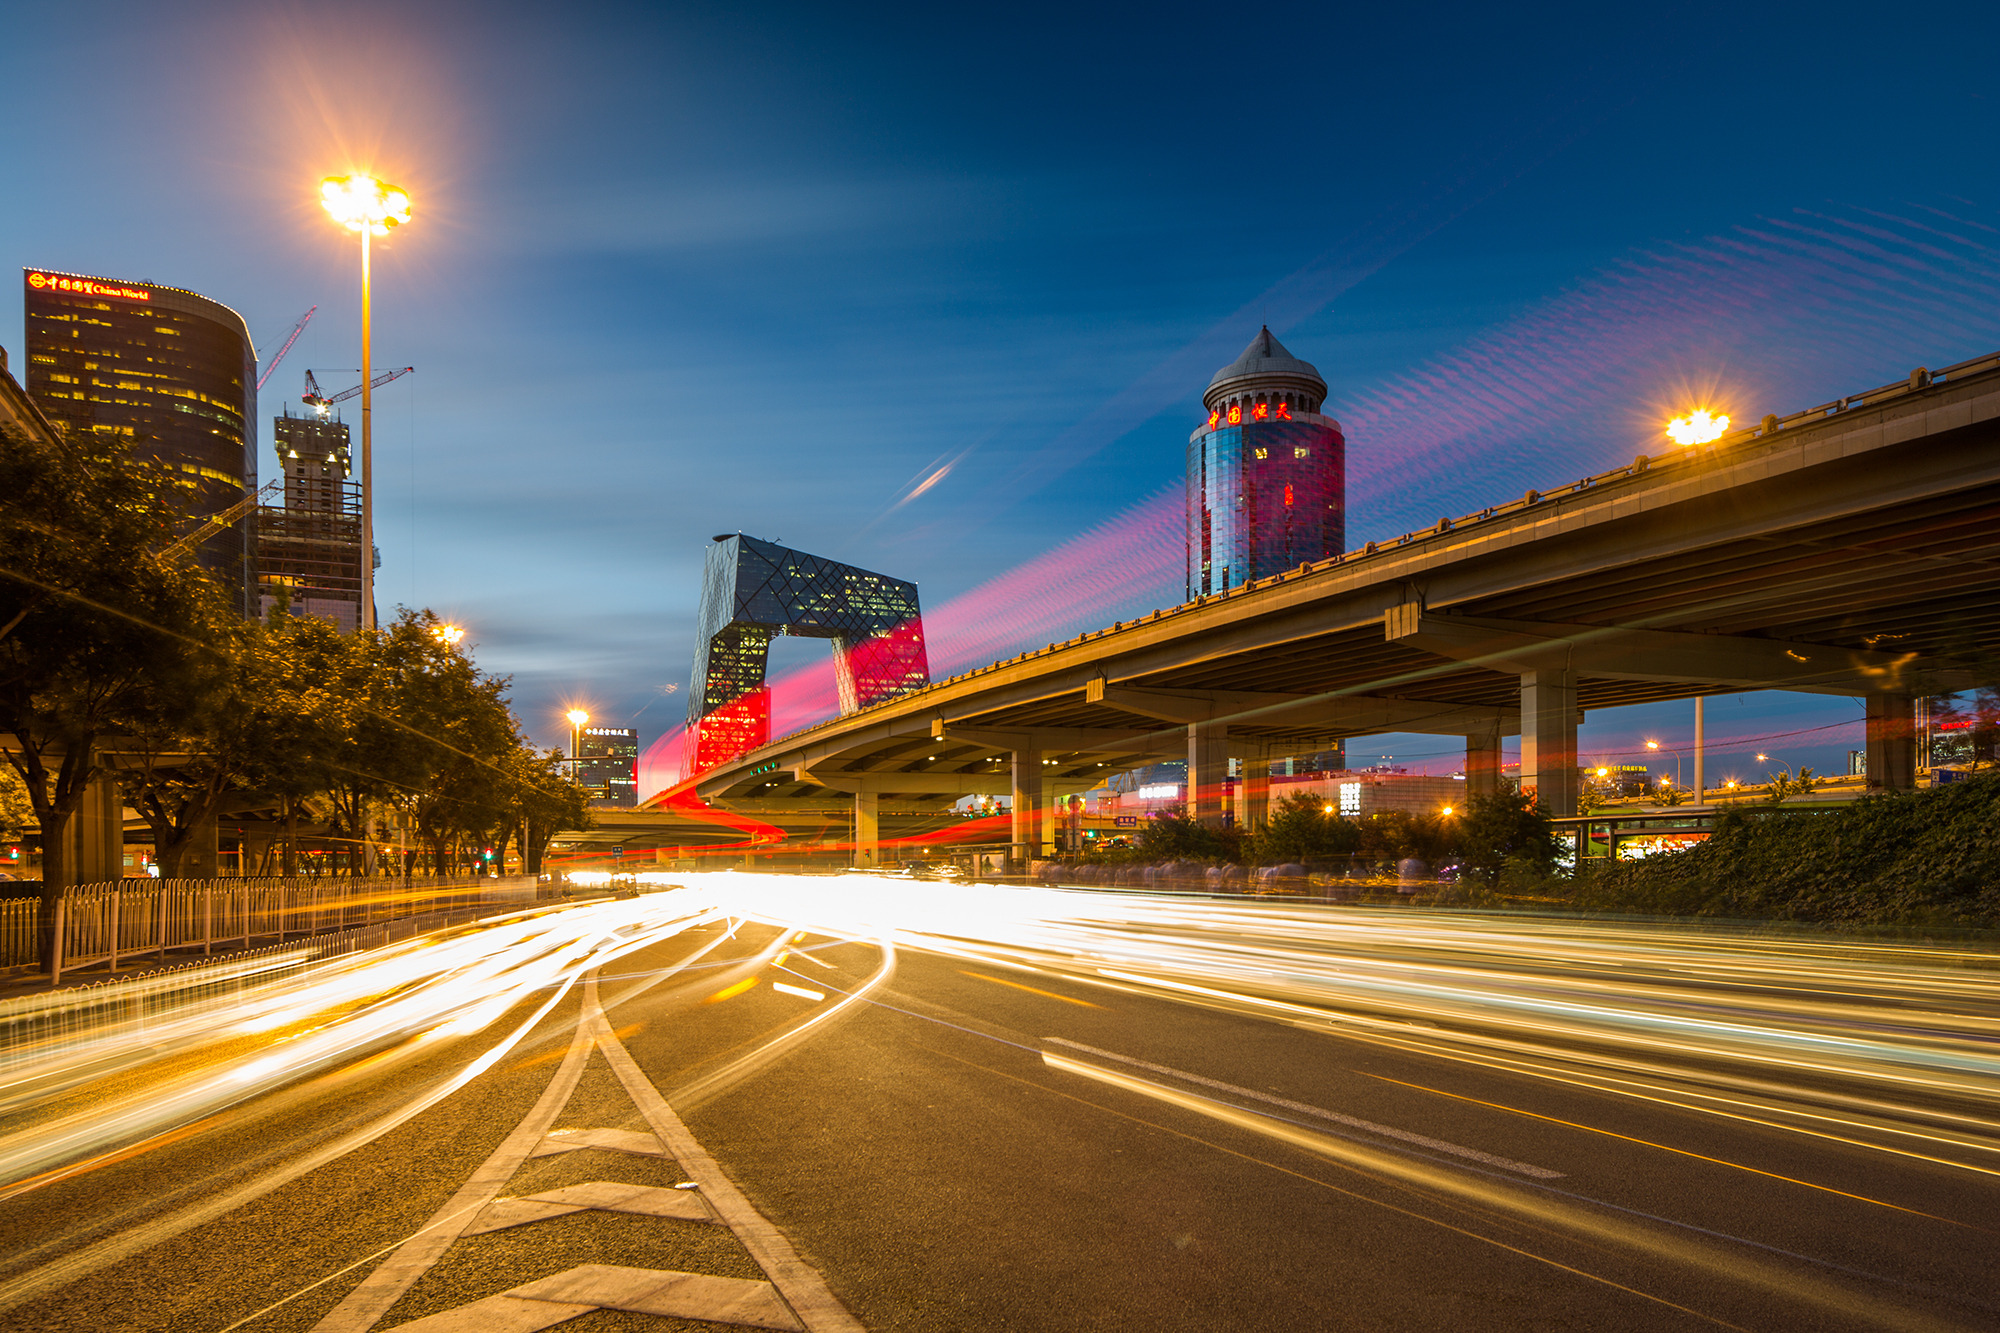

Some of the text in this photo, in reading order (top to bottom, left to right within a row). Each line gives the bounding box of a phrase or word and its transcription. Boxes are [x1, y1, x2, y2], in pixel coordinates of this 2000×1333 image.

[93, 285, 149, 300] China World
[1208, 403, 1292, 430] 中国恒天
